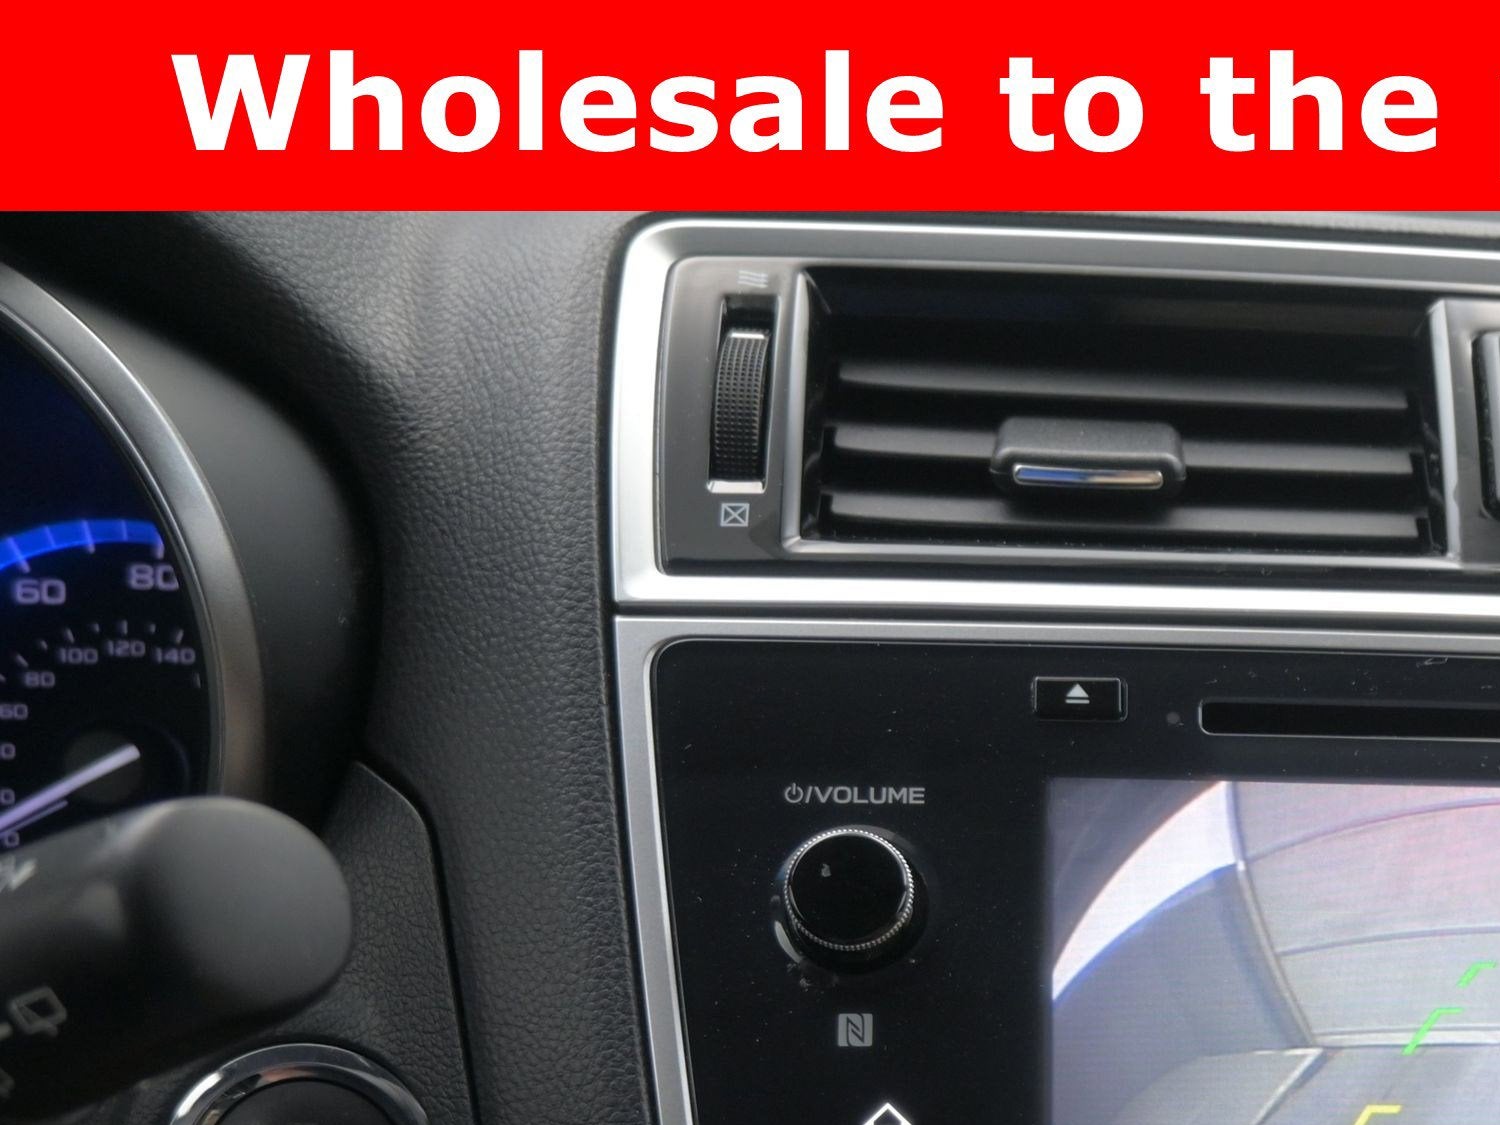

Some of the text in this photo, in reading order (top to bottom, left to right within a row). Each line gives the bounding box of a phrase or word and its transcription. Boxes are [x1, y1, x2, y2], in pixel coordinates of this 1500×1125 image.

[127, 564, 179, 591] 80
[14, 578, 66, 604] 60
[58, 646, 98, 664] 100
[105, 640, 146, 657] 120
[154, 646, 195, 664] 140
[24, 670, 56, 687] 80
